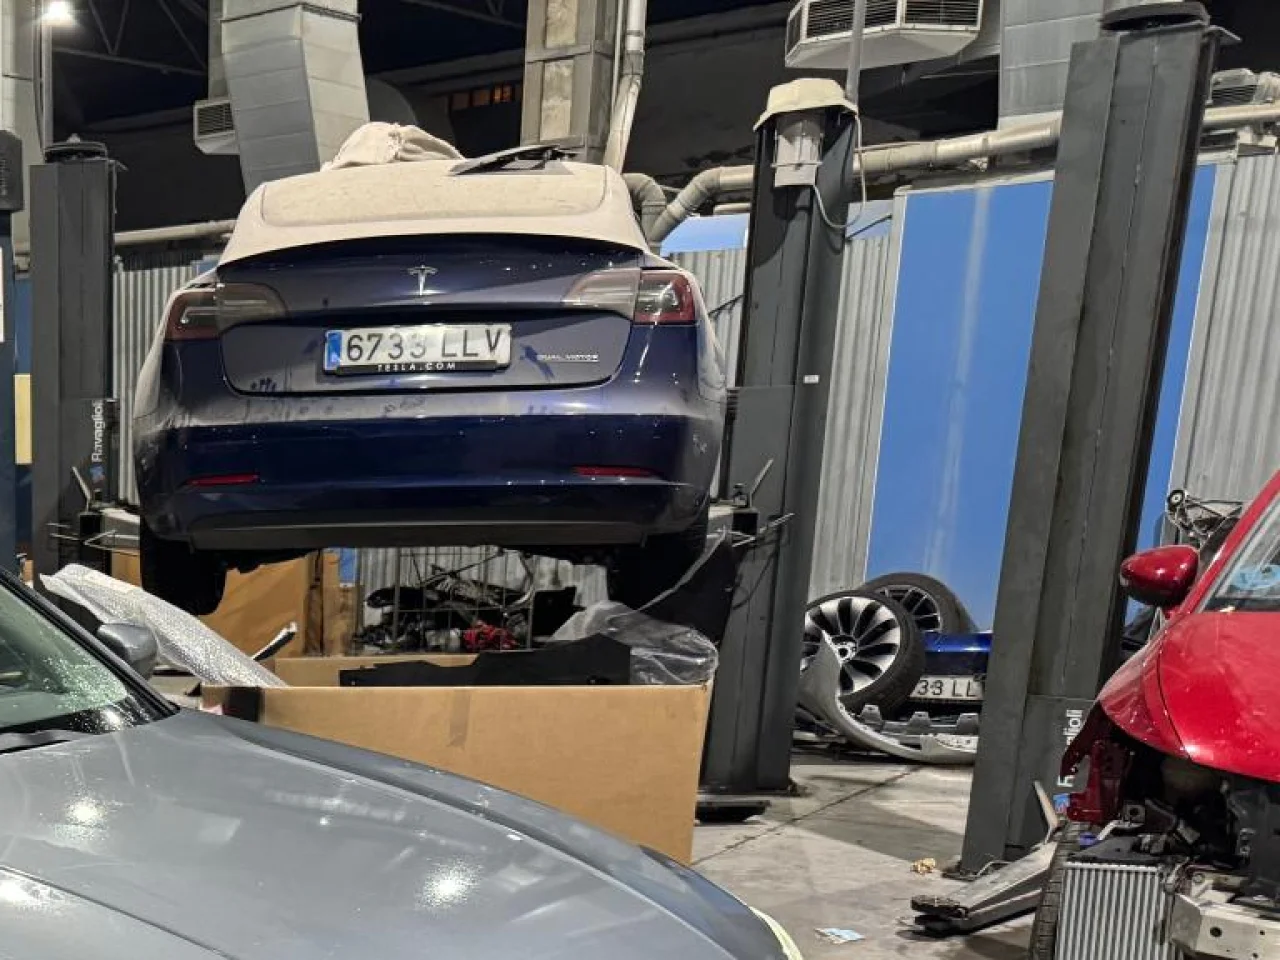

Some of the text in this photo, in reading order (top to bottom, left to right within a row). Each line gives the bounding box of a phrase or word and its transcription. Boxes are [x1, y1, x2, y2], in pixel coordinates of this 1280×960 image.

[346, 328, 503, 361] 6733 LLV
[377, 361, 456, 372] TESLA.COM
